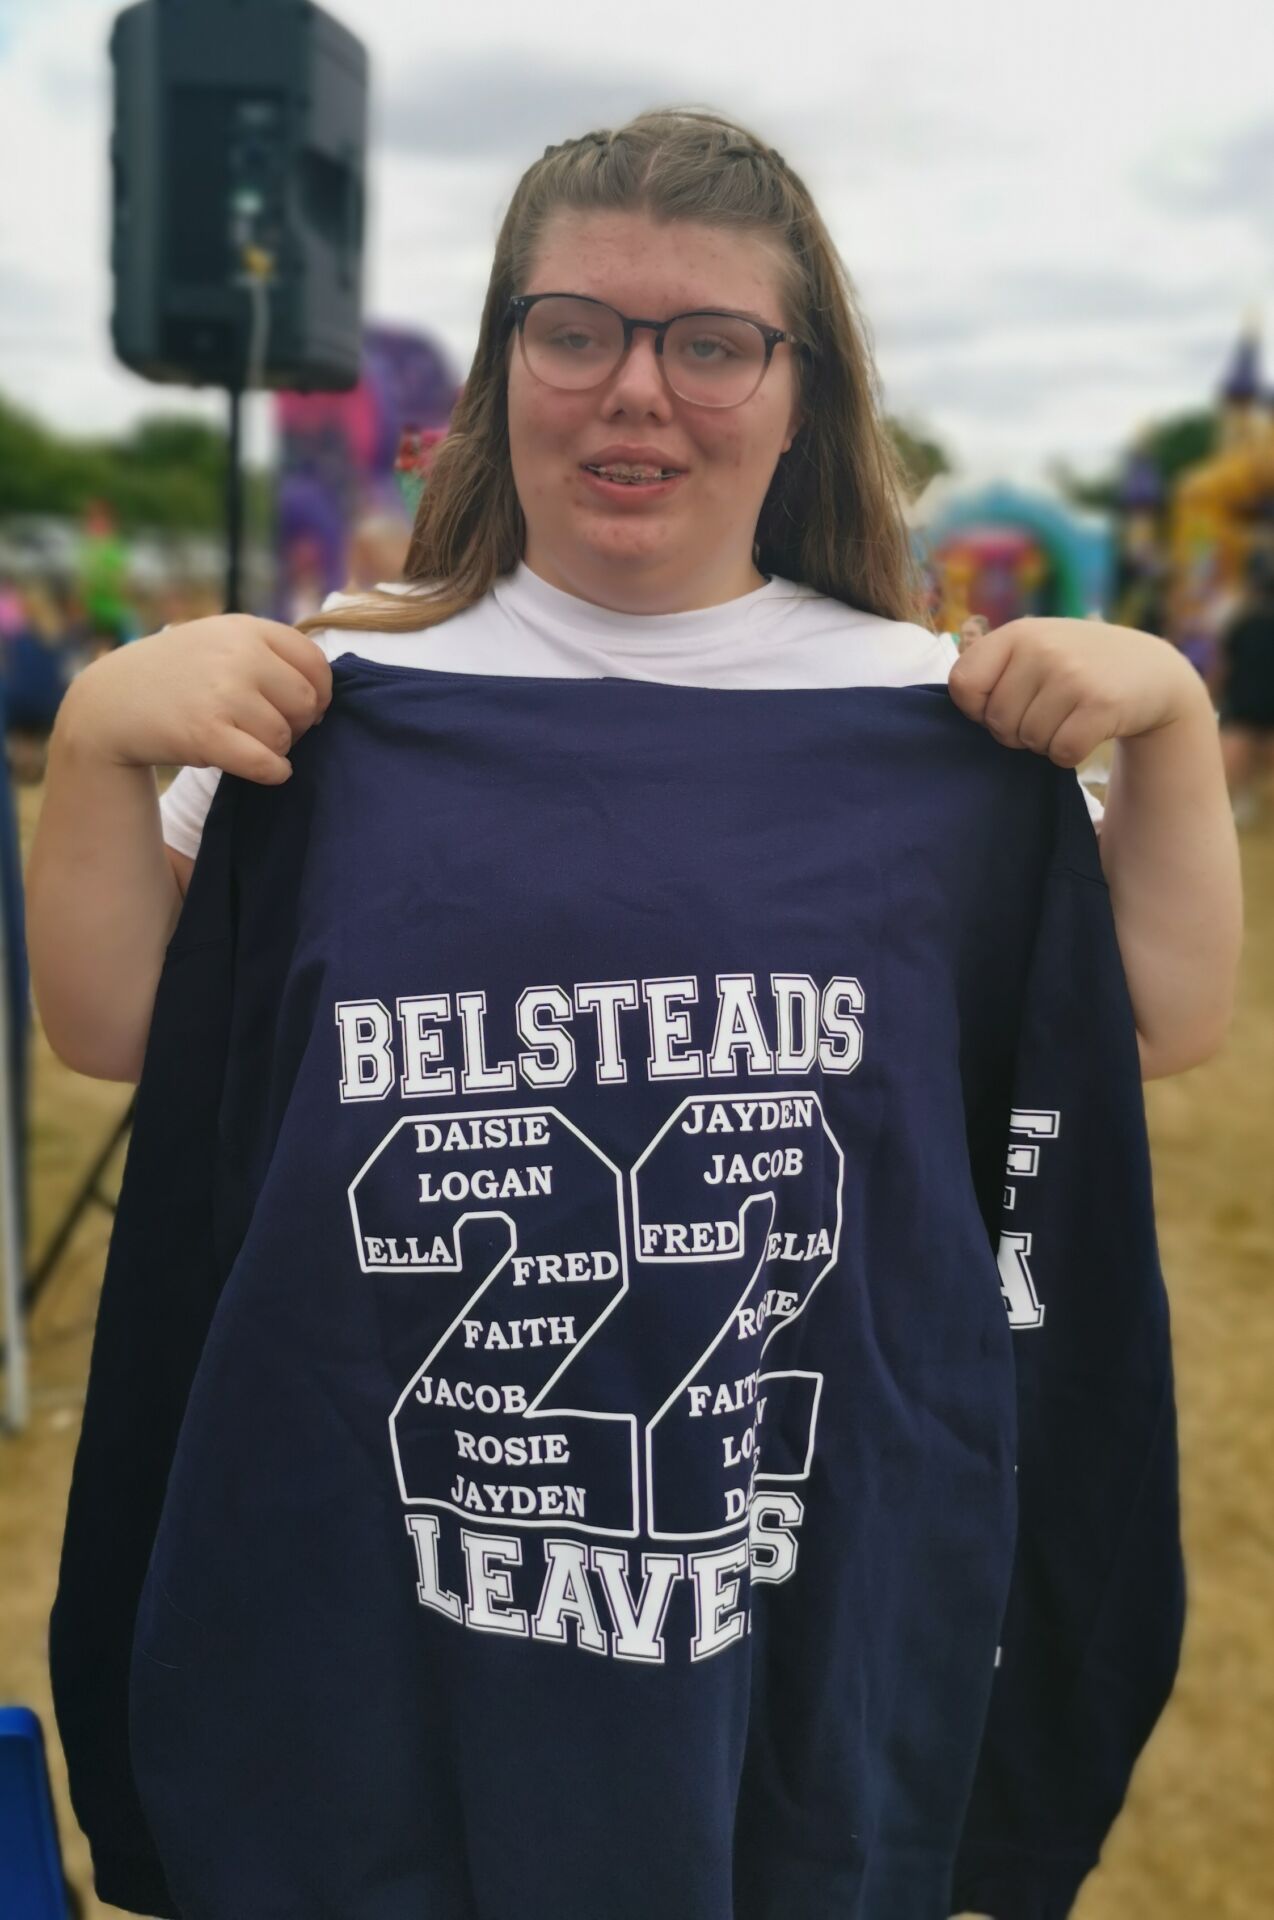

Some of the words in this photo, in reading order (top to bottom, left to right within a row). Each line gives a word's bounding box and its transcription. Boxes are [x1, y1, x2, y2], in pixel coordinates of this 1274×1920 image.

[335, 974, 864, 1103] BELSTEADS
[415, 1115, 551, 1153] DAISIE
[682, 1099, 814, 1134] JAYDEN
[418, 1165, 553, 1202] LOGAN
[703, 1148, 803, 1185] JACOB
[364, 1236, 453, 1264] ELLA
[640, 1221, 739, 1254] FRED
[511, 1251, 619, 1286] FRED
[462, 1316, 577, 1350] FAITH
[735, 1289, 798, 1340] ROIE
[415, 1376, 528, 1414] JACOB
[687, 1368, 760, 1417] FAIT
[454, 1430, 570, 1466] ROSIE
[451, 1475, 586, 1517] JAYDEN
[405, 1491, 804, 1664] LEAVES
